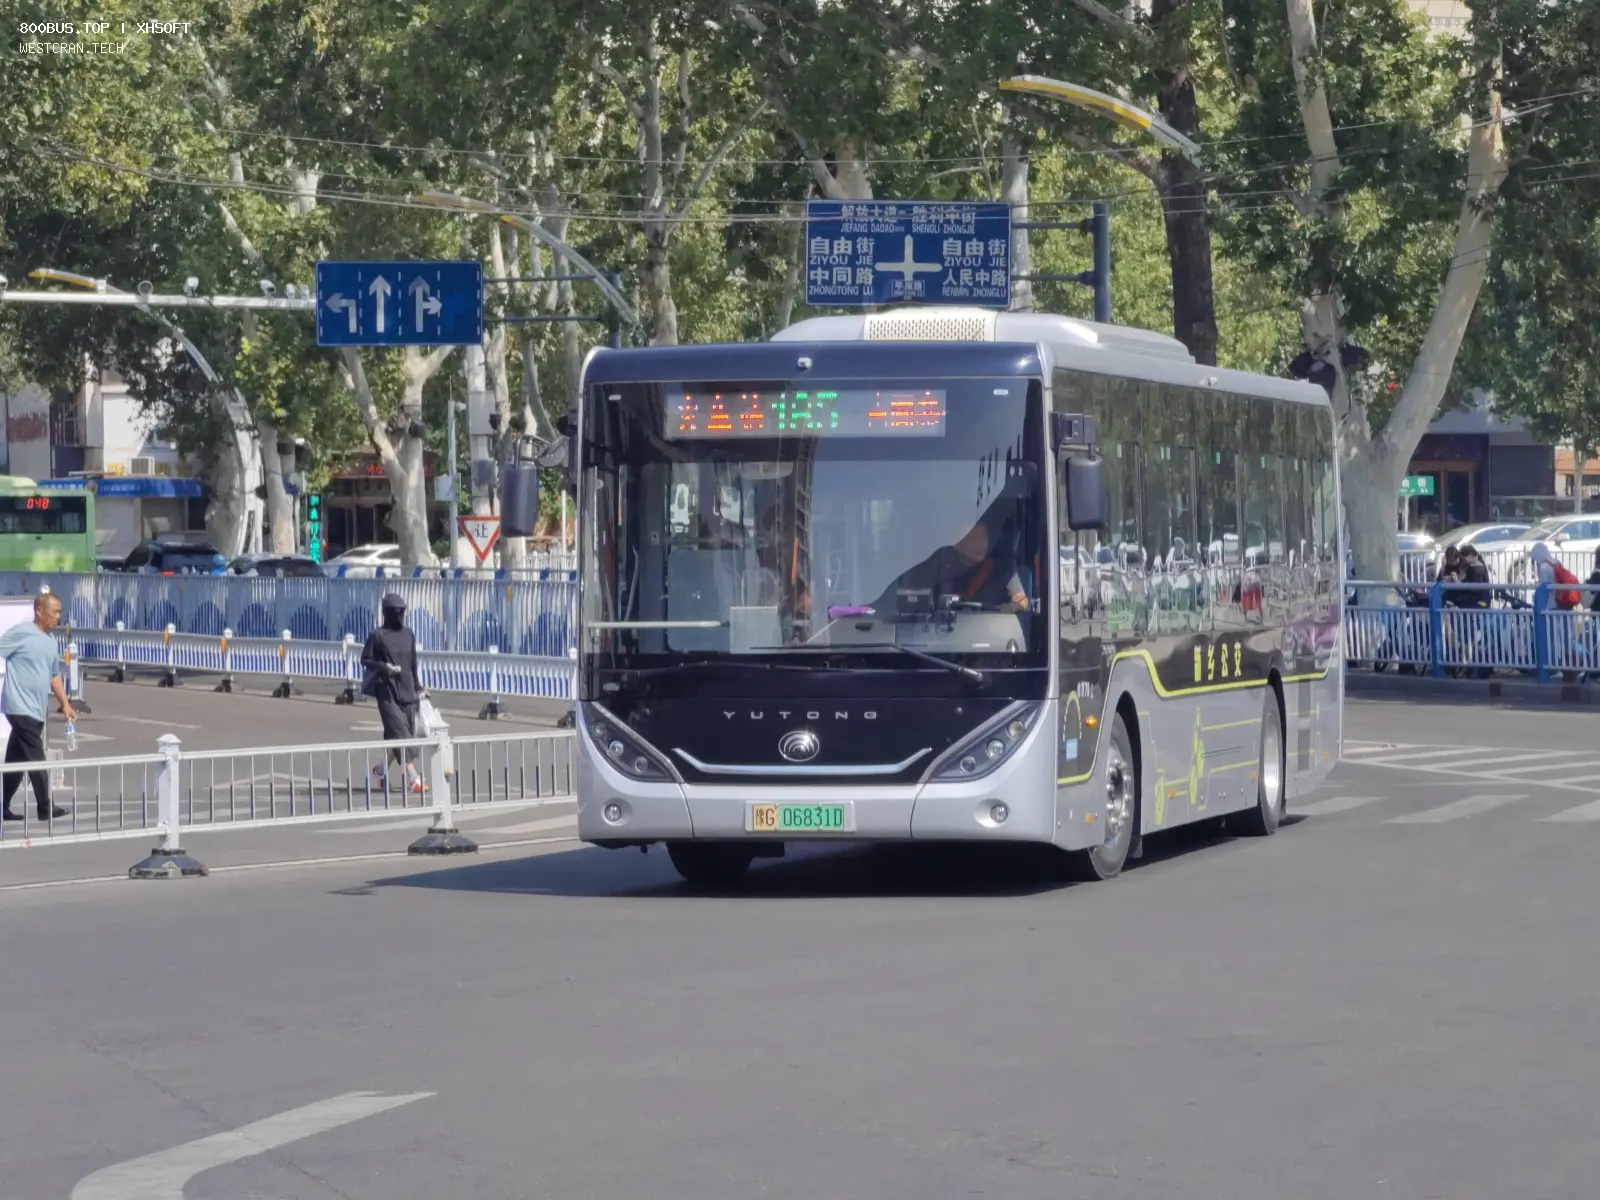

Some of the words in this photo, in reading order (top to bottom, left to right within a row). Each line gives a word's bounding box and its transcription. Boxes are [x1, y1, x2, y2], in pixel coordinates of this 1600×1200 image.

[841, 223, 868, 232] JIEFANG
[871, 224, 894, 233] DADAO
[810, 236, 874, 255] 自由街
[943, 238, 1007, 256] 自由街
[809, 255, 848, 265] ZIYOU
[855, 256, 873, 265] JIE
[944, 257, 982, 267] ZIYOU
[988, 257, 1007, 267] JIE
[809, 267, 873, 286] 中同路
[942, 269, 1007, 286] 人民中路
[809, 286, 859, 295] ZHONGTONG
[862, 286, 873, 295] LU
[942, 287, 969, 296] RENMIN
[972, 287, 1007, 297] ZHONGLU
[26, 497, 50, 509] 048
[723, 711, 877, 719] YUTONG
